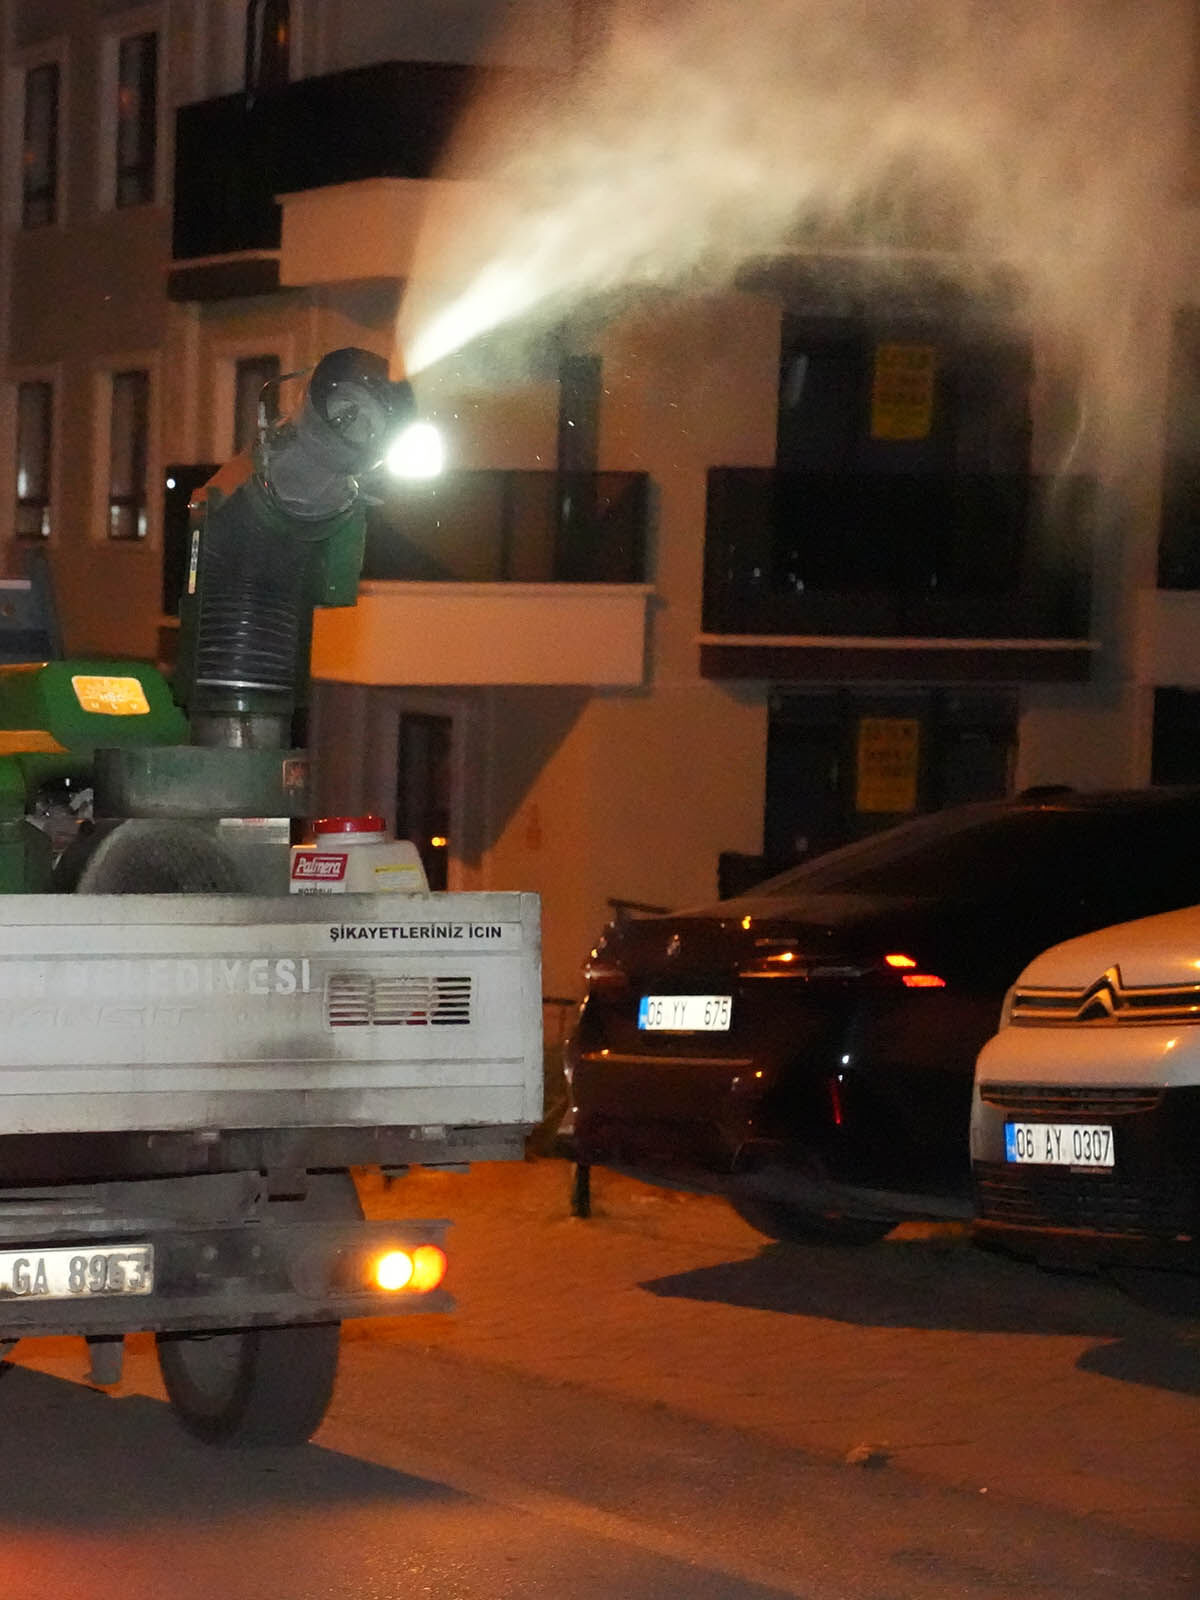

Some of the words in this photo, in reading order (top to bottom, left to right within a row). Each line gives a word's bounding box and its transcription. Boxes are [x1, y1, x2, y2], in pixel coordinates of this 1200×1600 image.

[296, 856, 342, 874] Palmera
[330, 923, 463, 942] ŞİKAYETLERİNİZ
[647, 1000, 663, 1026] 06
[673, 1000, 688, 1025] YY
[703, 1000, 730, 1026] 675
[1016, 1128, 1034, 1159] 06
[1045, 1128, 1062, 1160] AY
[1072, 1129, 1111, 1162] 0307
[13, 1257, 49, 1294] GA
